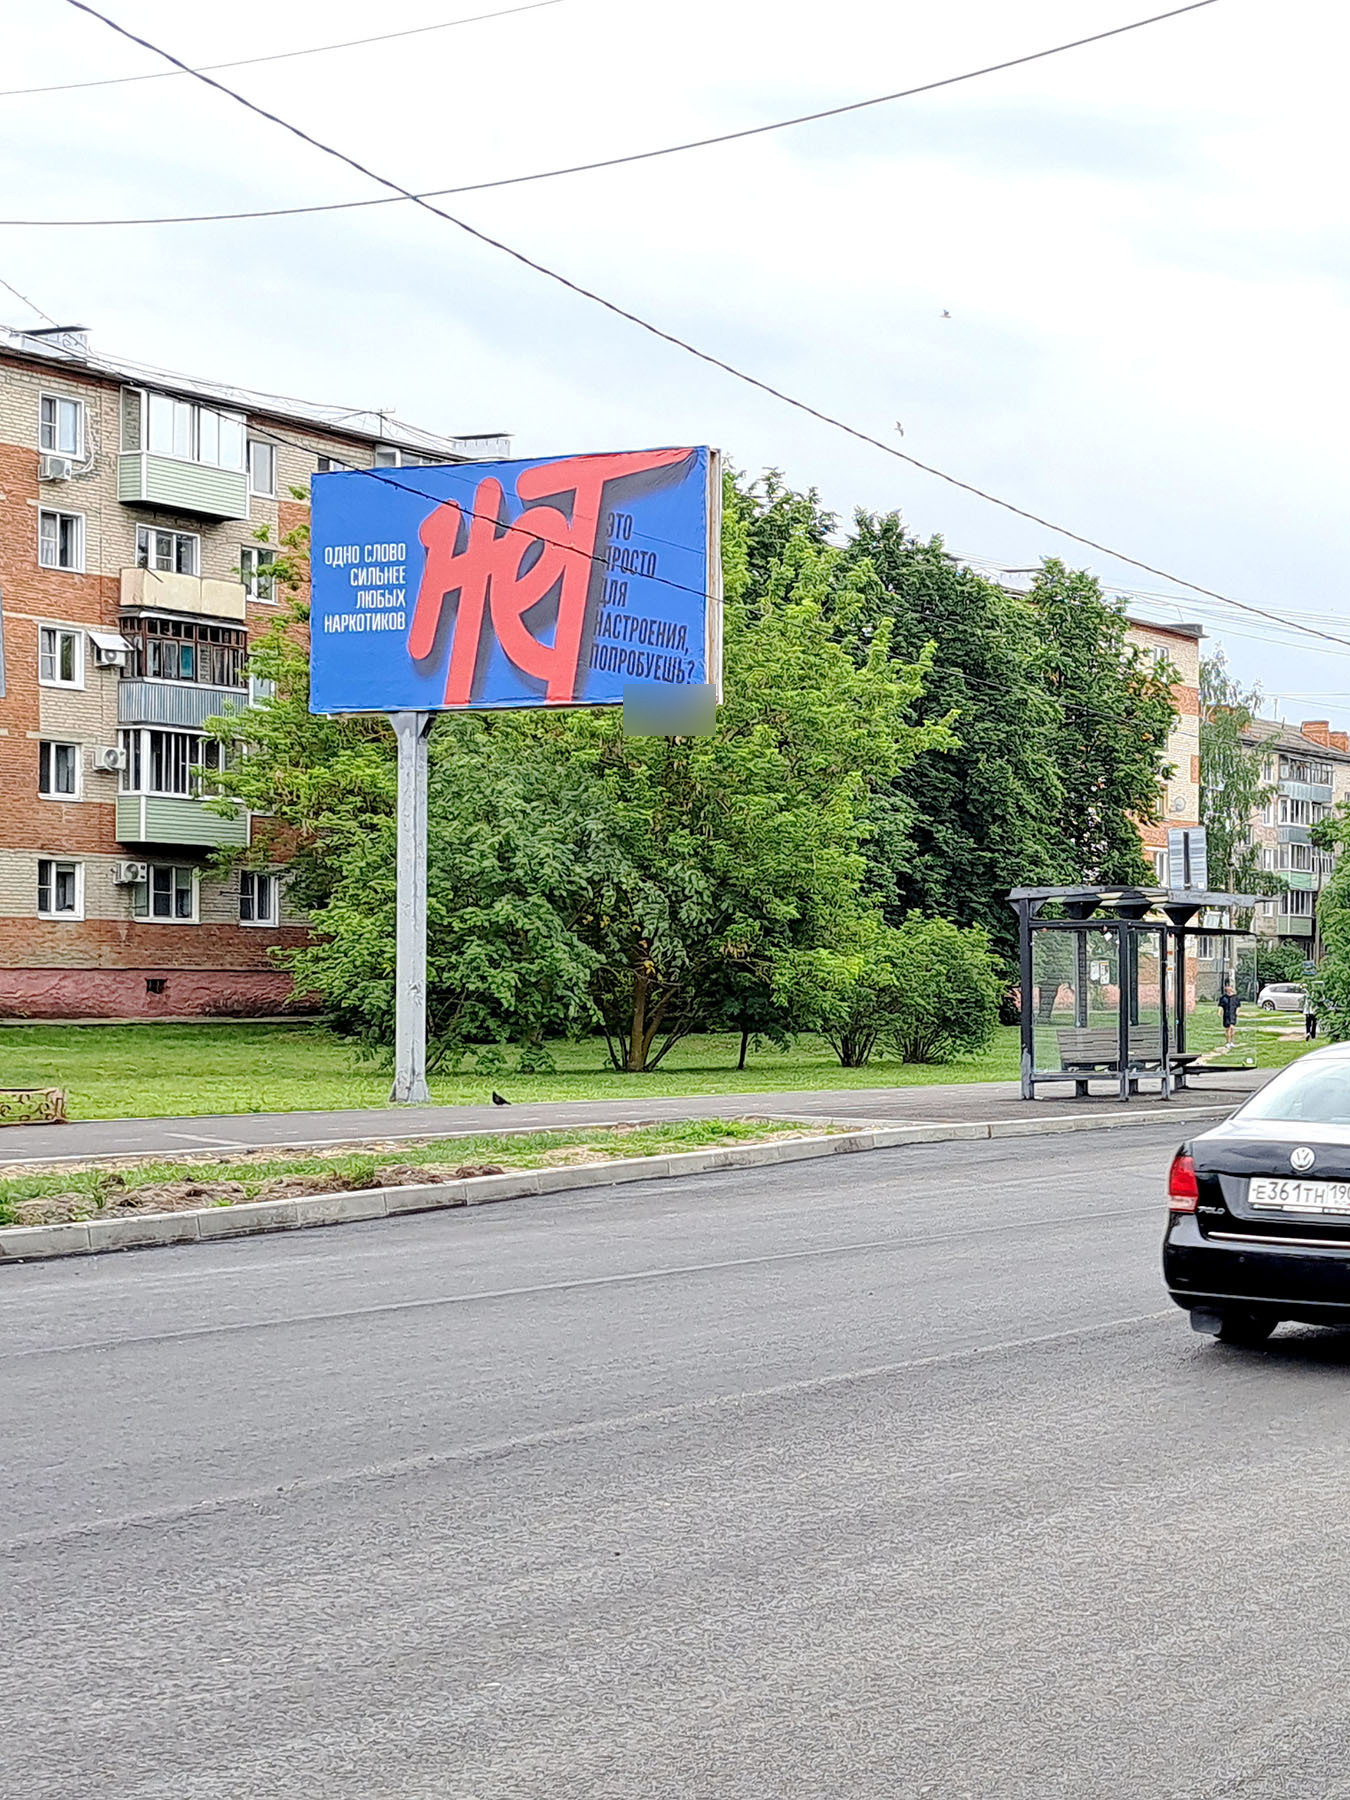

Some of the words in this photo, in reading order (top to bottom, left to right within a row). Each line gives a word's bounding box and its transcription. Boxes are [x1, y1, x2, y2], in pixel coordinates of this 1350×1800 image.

[606, 511, 634, 542] ЭТО
[324, 545, 360, 569] ОДНО
[364, 543, 406, 563] СЛОВО
[350, 565, 407, 587] СИЛЬНЕЕ
[355, 588, 406, 609] ЛЮБЫХ
[324, 611, 406, 633] НАРКОТИКОВ
[593, 610, 689, 656] НАСТРОЕНИЯ,
[588, 642, 696, 685] ПОПРОБУЕШЬ?
